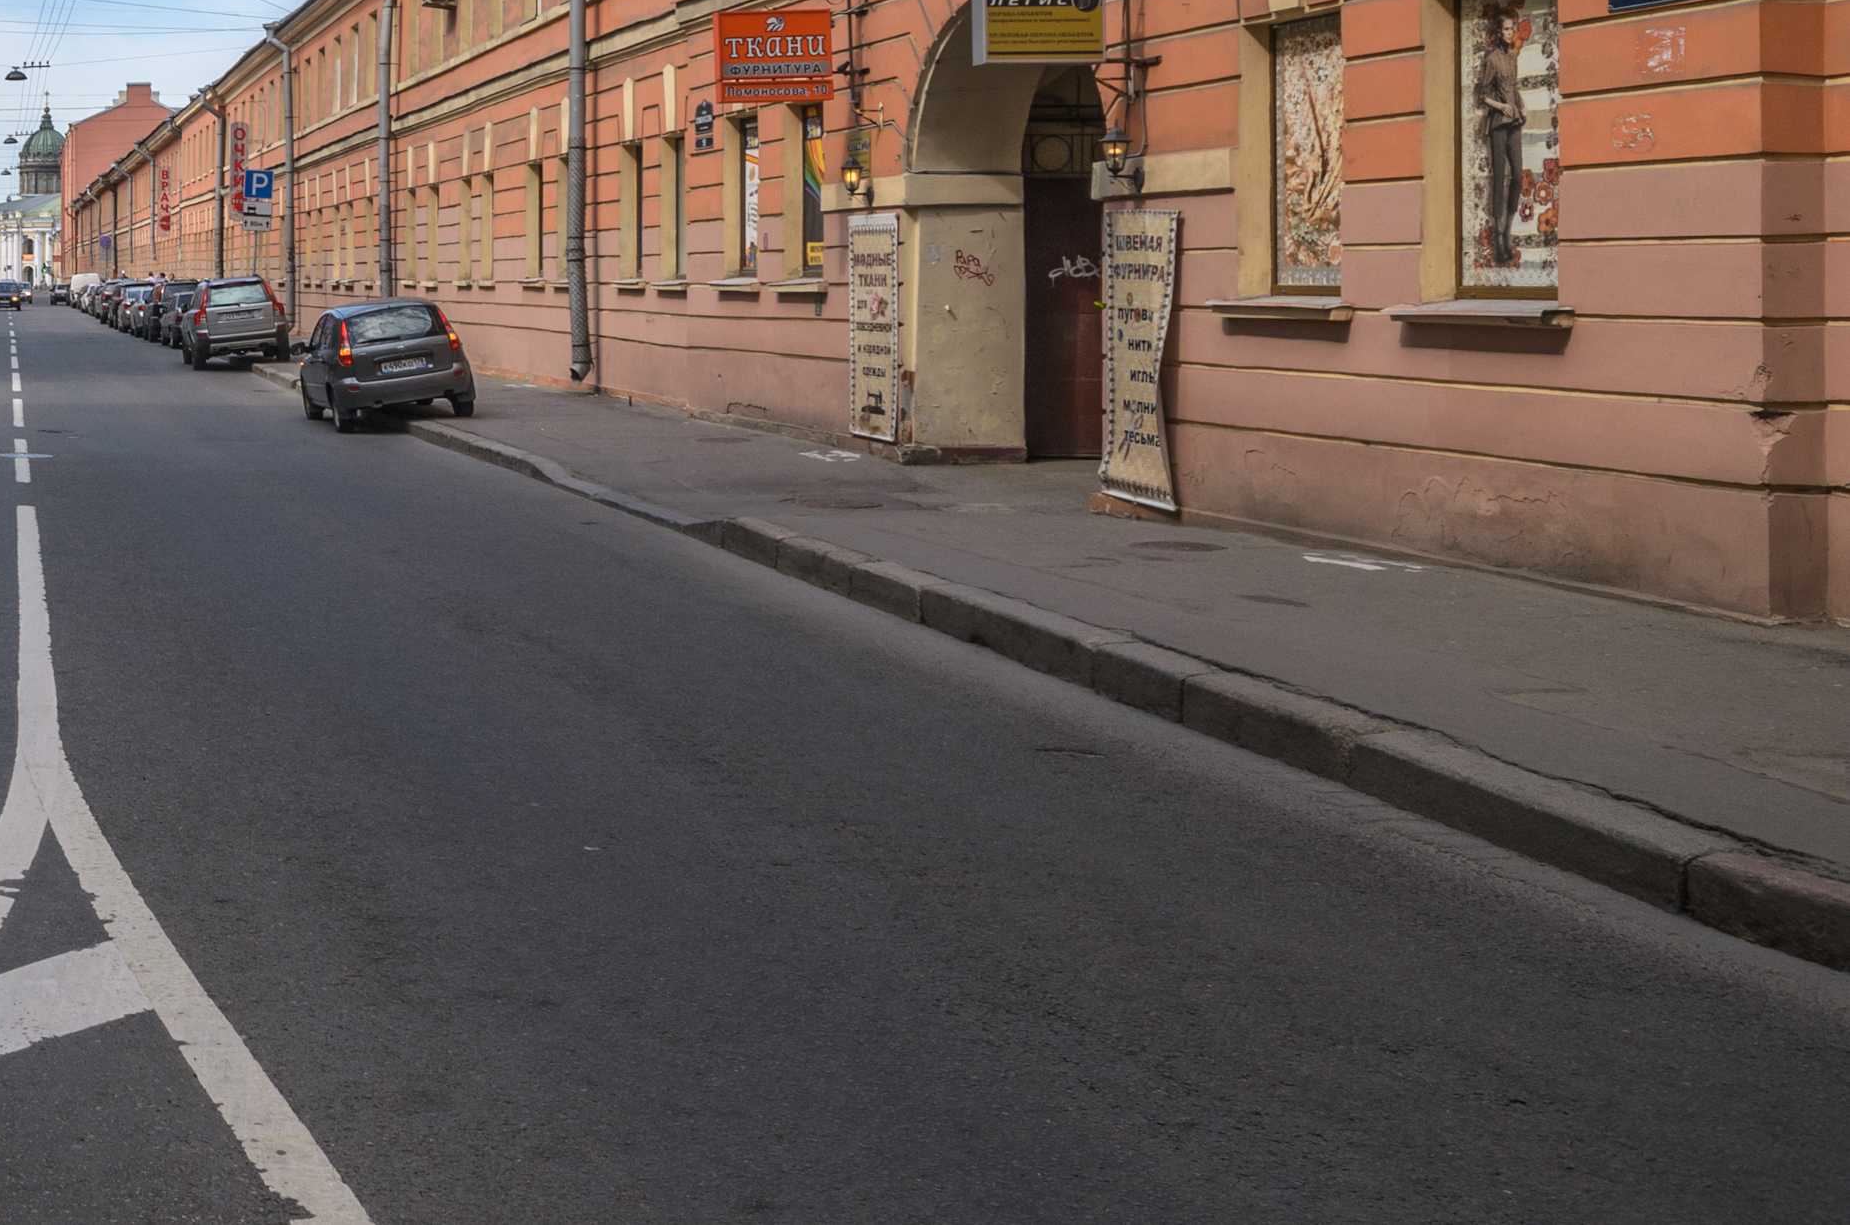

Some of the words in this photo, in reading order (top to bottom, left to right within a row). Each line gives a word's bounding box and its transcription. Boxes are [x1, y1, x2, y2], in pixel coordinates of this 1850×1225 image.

[730, 64, 822, 76] ФУРНИТУРА
[725, 86, 810, 97] Ломоносова,
[813, 84, 828, 95] 10
[233, 127, 246, 188] ОЧКИ
[161, 170, 169, 213] ВРАЧ
[853, 254, 892, 269] МОДНЫЕ
[858, 274, 887, 287] ТКАНИ
